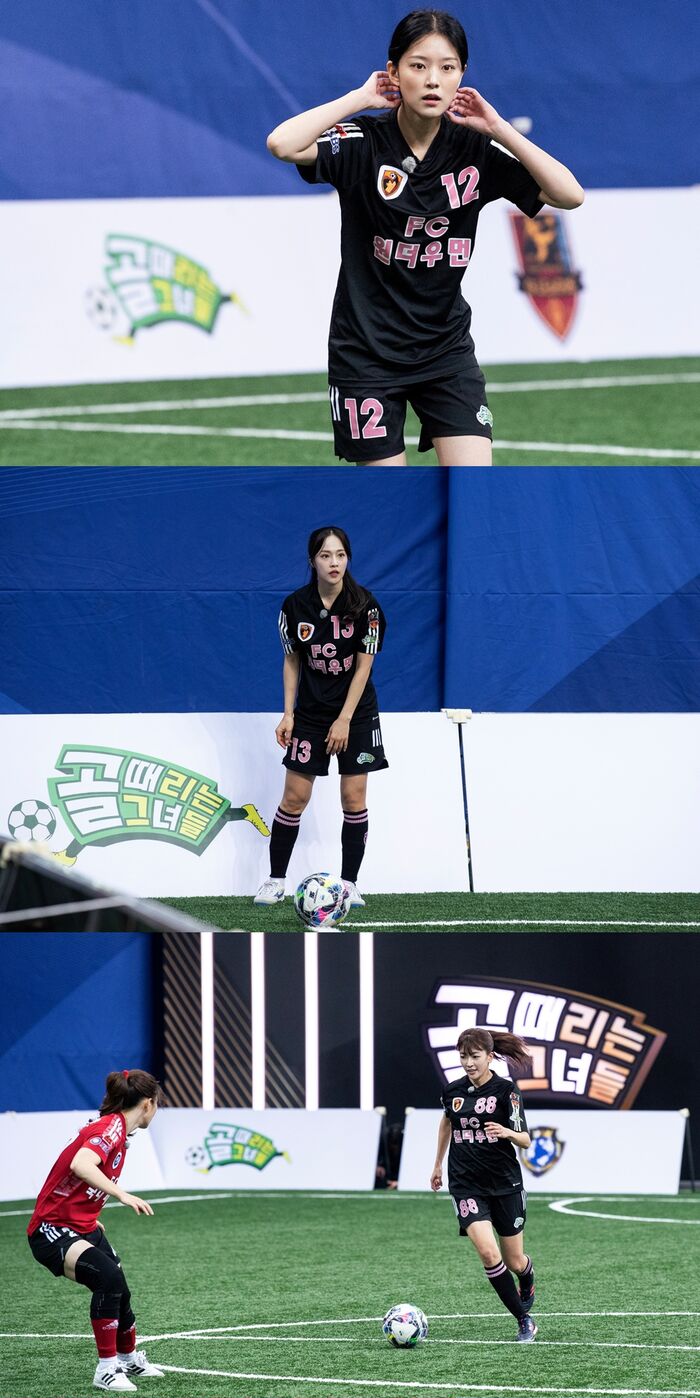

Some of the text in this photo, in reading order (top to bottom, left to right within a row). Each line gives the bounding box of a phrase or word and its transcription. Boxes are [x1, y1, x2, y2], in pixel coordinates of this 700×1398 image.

[441, 165, 480, 210] 12
[404, 216, 450, 238] FC
[373, 235, 472, 269] 원더우먼
[344, 397, 387, 440] 12
[330, 615, 355, 640] 13
[311, 643, 337, 658] FC
[290, 737, 312, 764] 13
[122, 793, 212, 841] 그녀들
[516, 1045, 631, 1105] 그녀들
[474, 1096, 497, 1114] 88
[460, 1117, 480, 1129] FC
[459, 1198, 479, 1218] 88
